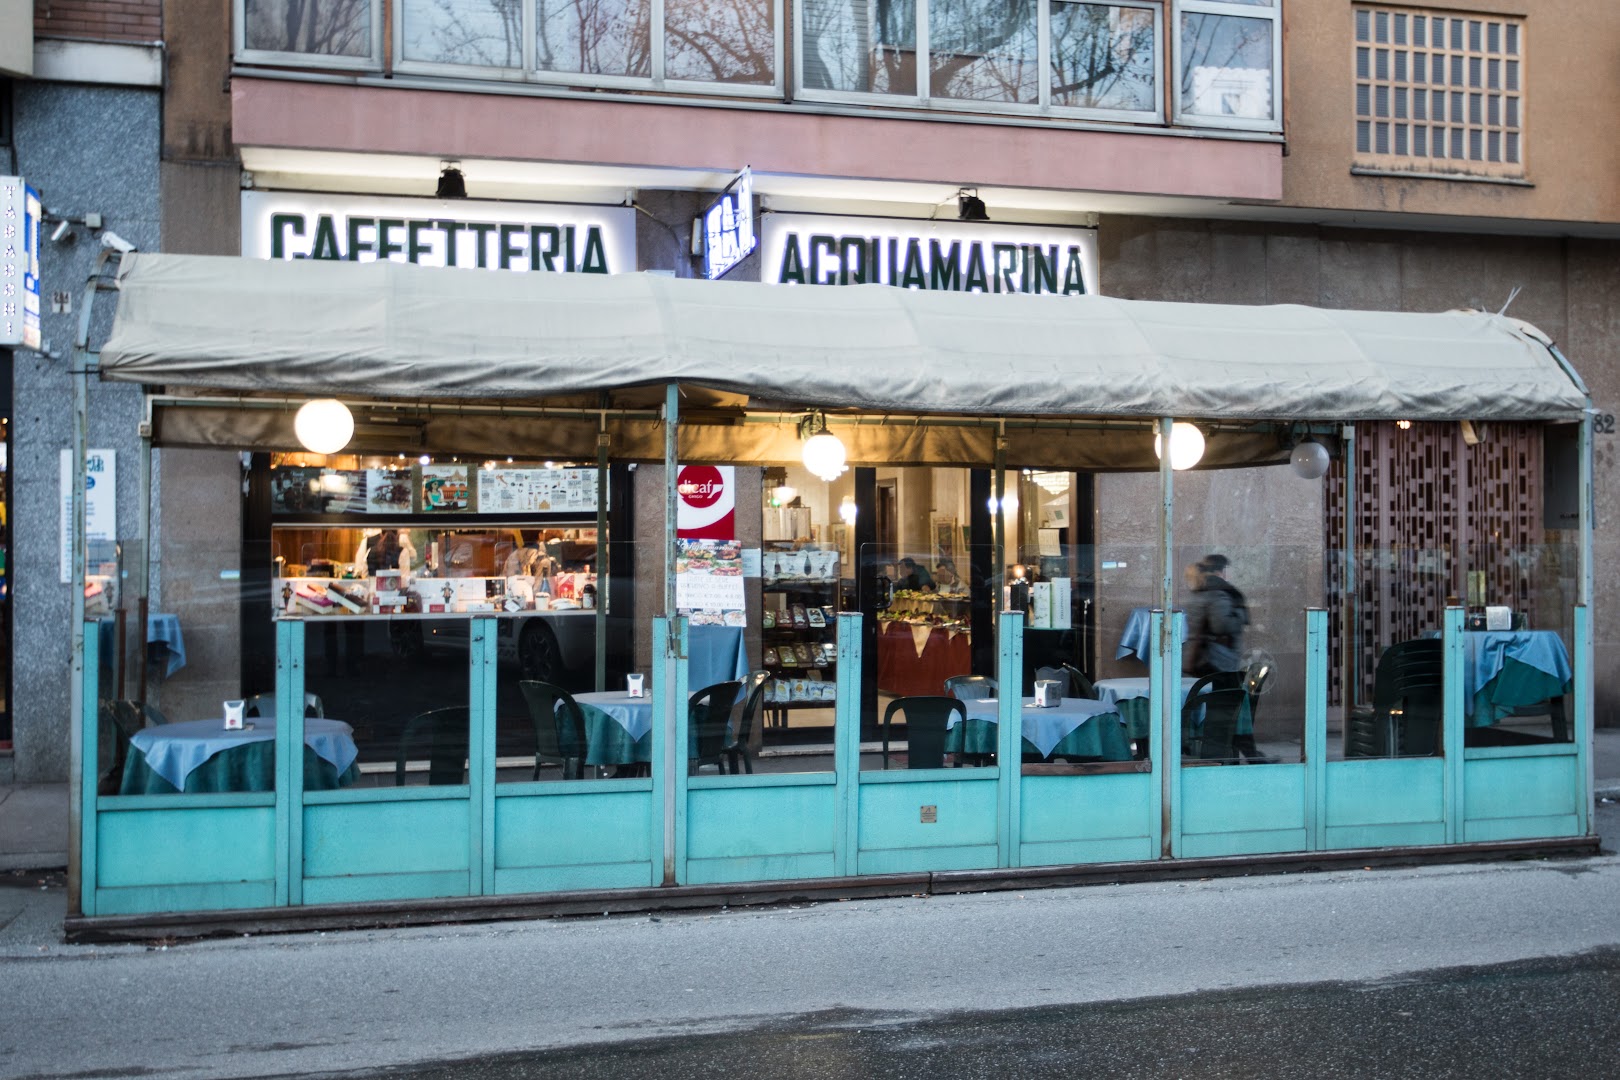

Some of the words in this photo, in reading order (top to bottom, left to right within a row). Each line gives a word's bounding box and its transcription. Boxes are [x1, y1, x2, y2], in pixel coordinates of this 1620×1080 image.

[3, 185, 17, 336] TABACCHI
[270, 211, 610, 275] CAFFETTERIA
[778, 232, 1087, 296] ACQUAMARINA
[1593, 414, 1615, 434] 82
